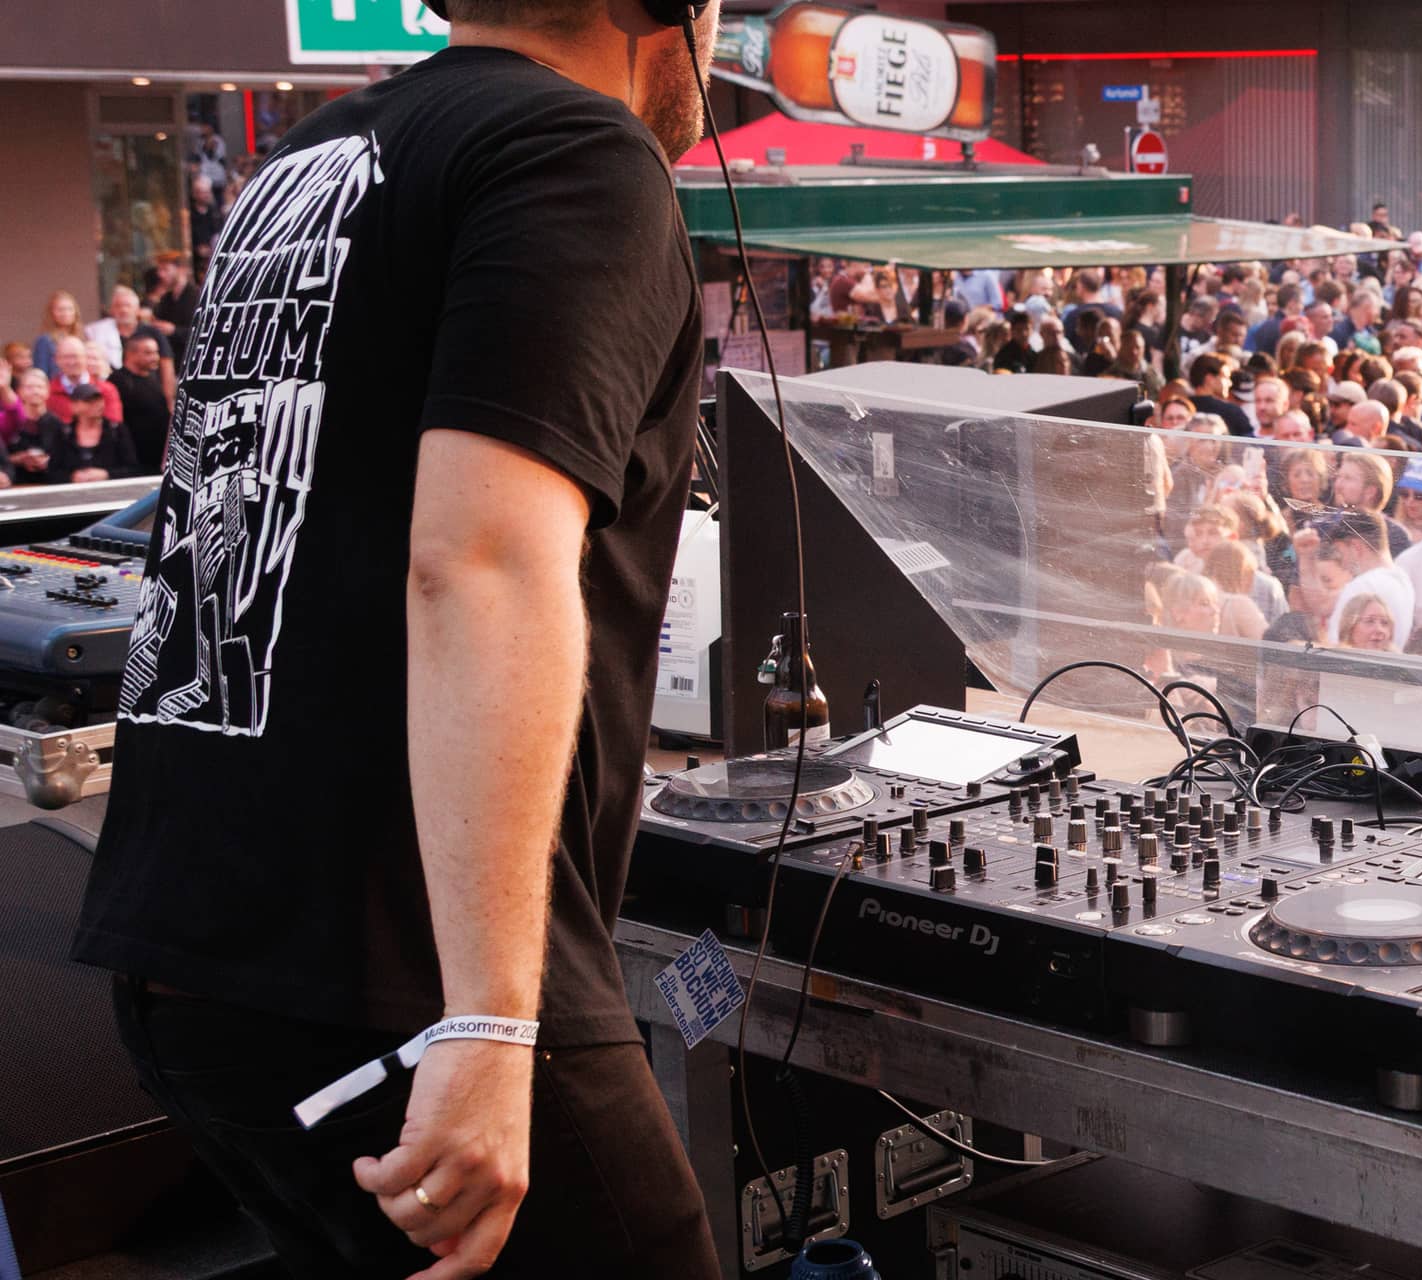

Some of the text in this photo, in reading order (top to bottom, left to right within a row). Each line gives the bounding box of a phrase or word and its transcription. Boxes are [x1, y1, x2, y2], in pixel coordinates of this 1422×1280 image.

[876, 28, 908, 118] FIEGE
[182, 298, 335, 384] CHUM
[858, 897, 964, 941] Pioneer
[667, 974, 680, 994] Die
[674, 952, 720, 1032] BOCHUM
[689, 941, 733, 1019] SO WIE IN
[700, 929, 746, 1008] NIRGENDWO
[424, 1020, 518, 1042] Musiksommer
[654, 971, 696, 1047] Feuersteins
